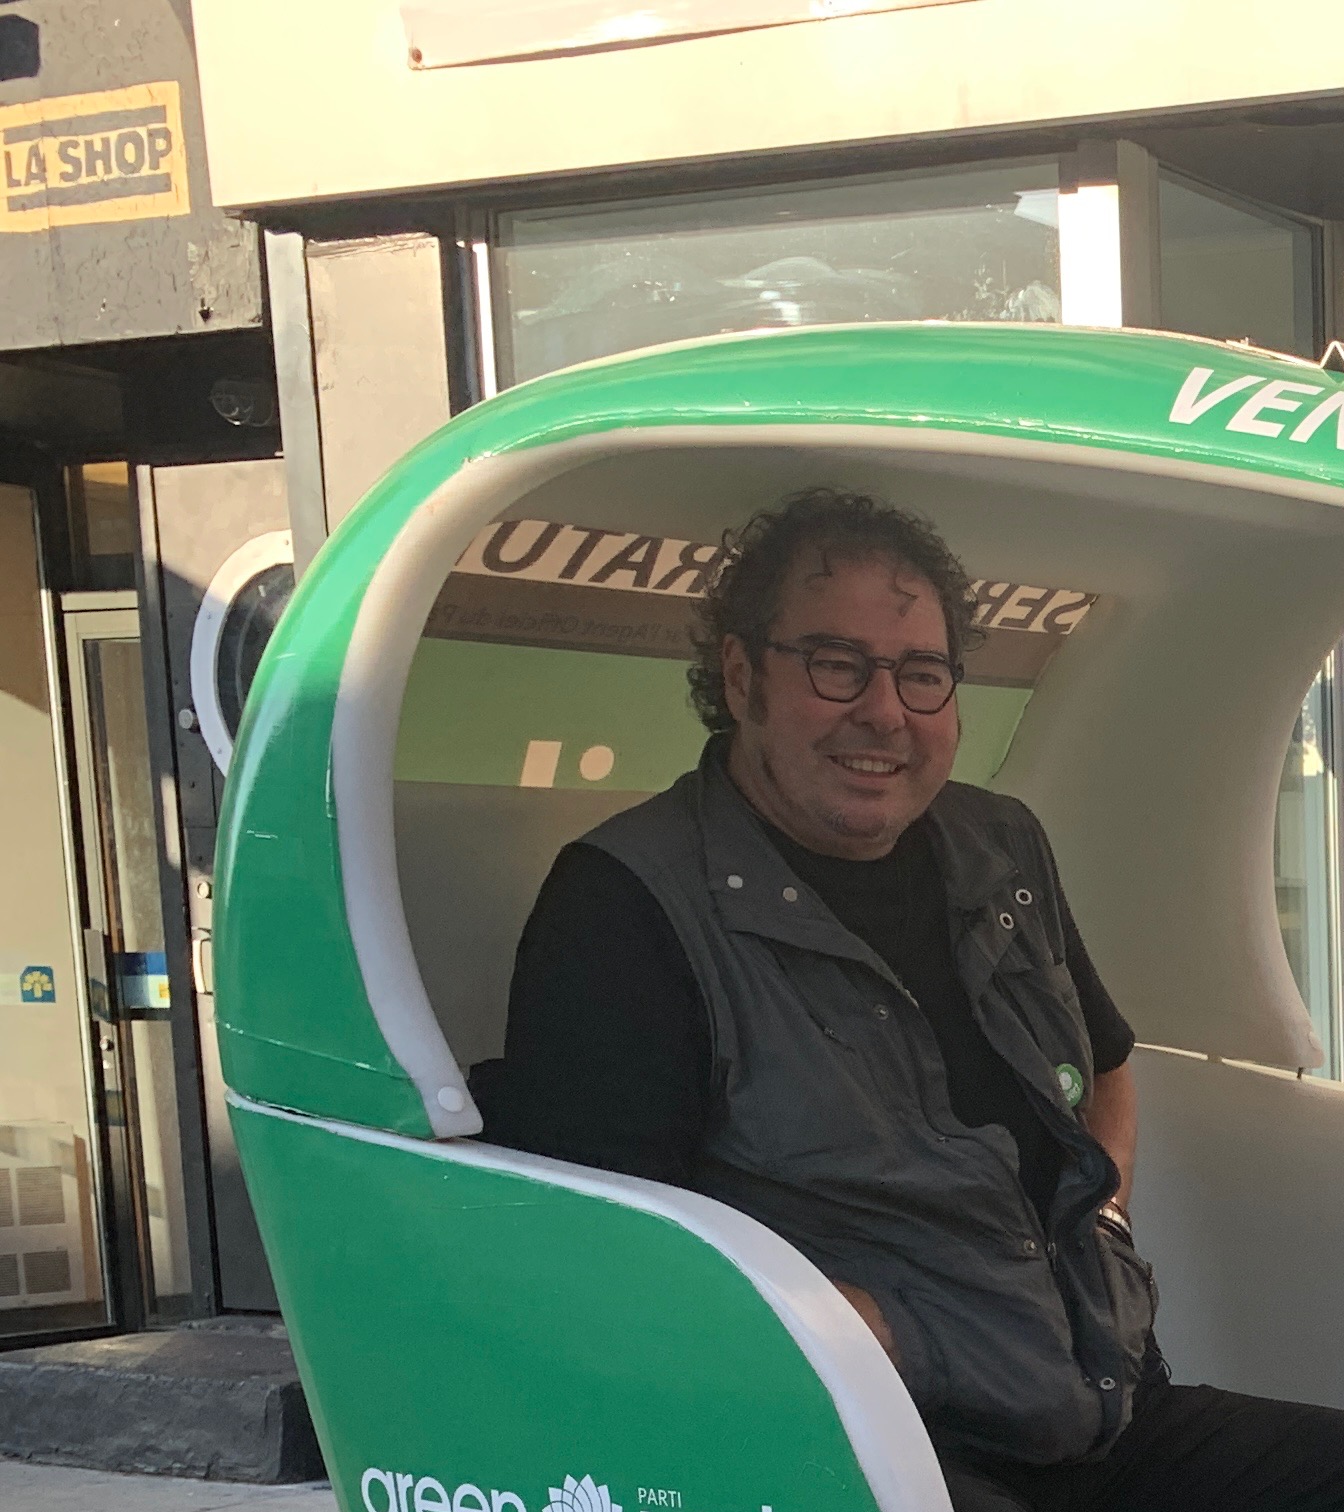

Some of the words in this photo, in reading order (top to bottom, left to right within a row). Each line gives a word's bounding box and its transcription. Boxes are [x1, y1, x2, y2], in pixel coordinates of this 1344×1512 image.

[3, 141, 46, 188] LA
[59, 128, 172, 182] SHOP
[637, 1487, 682, 1508] PARTI
